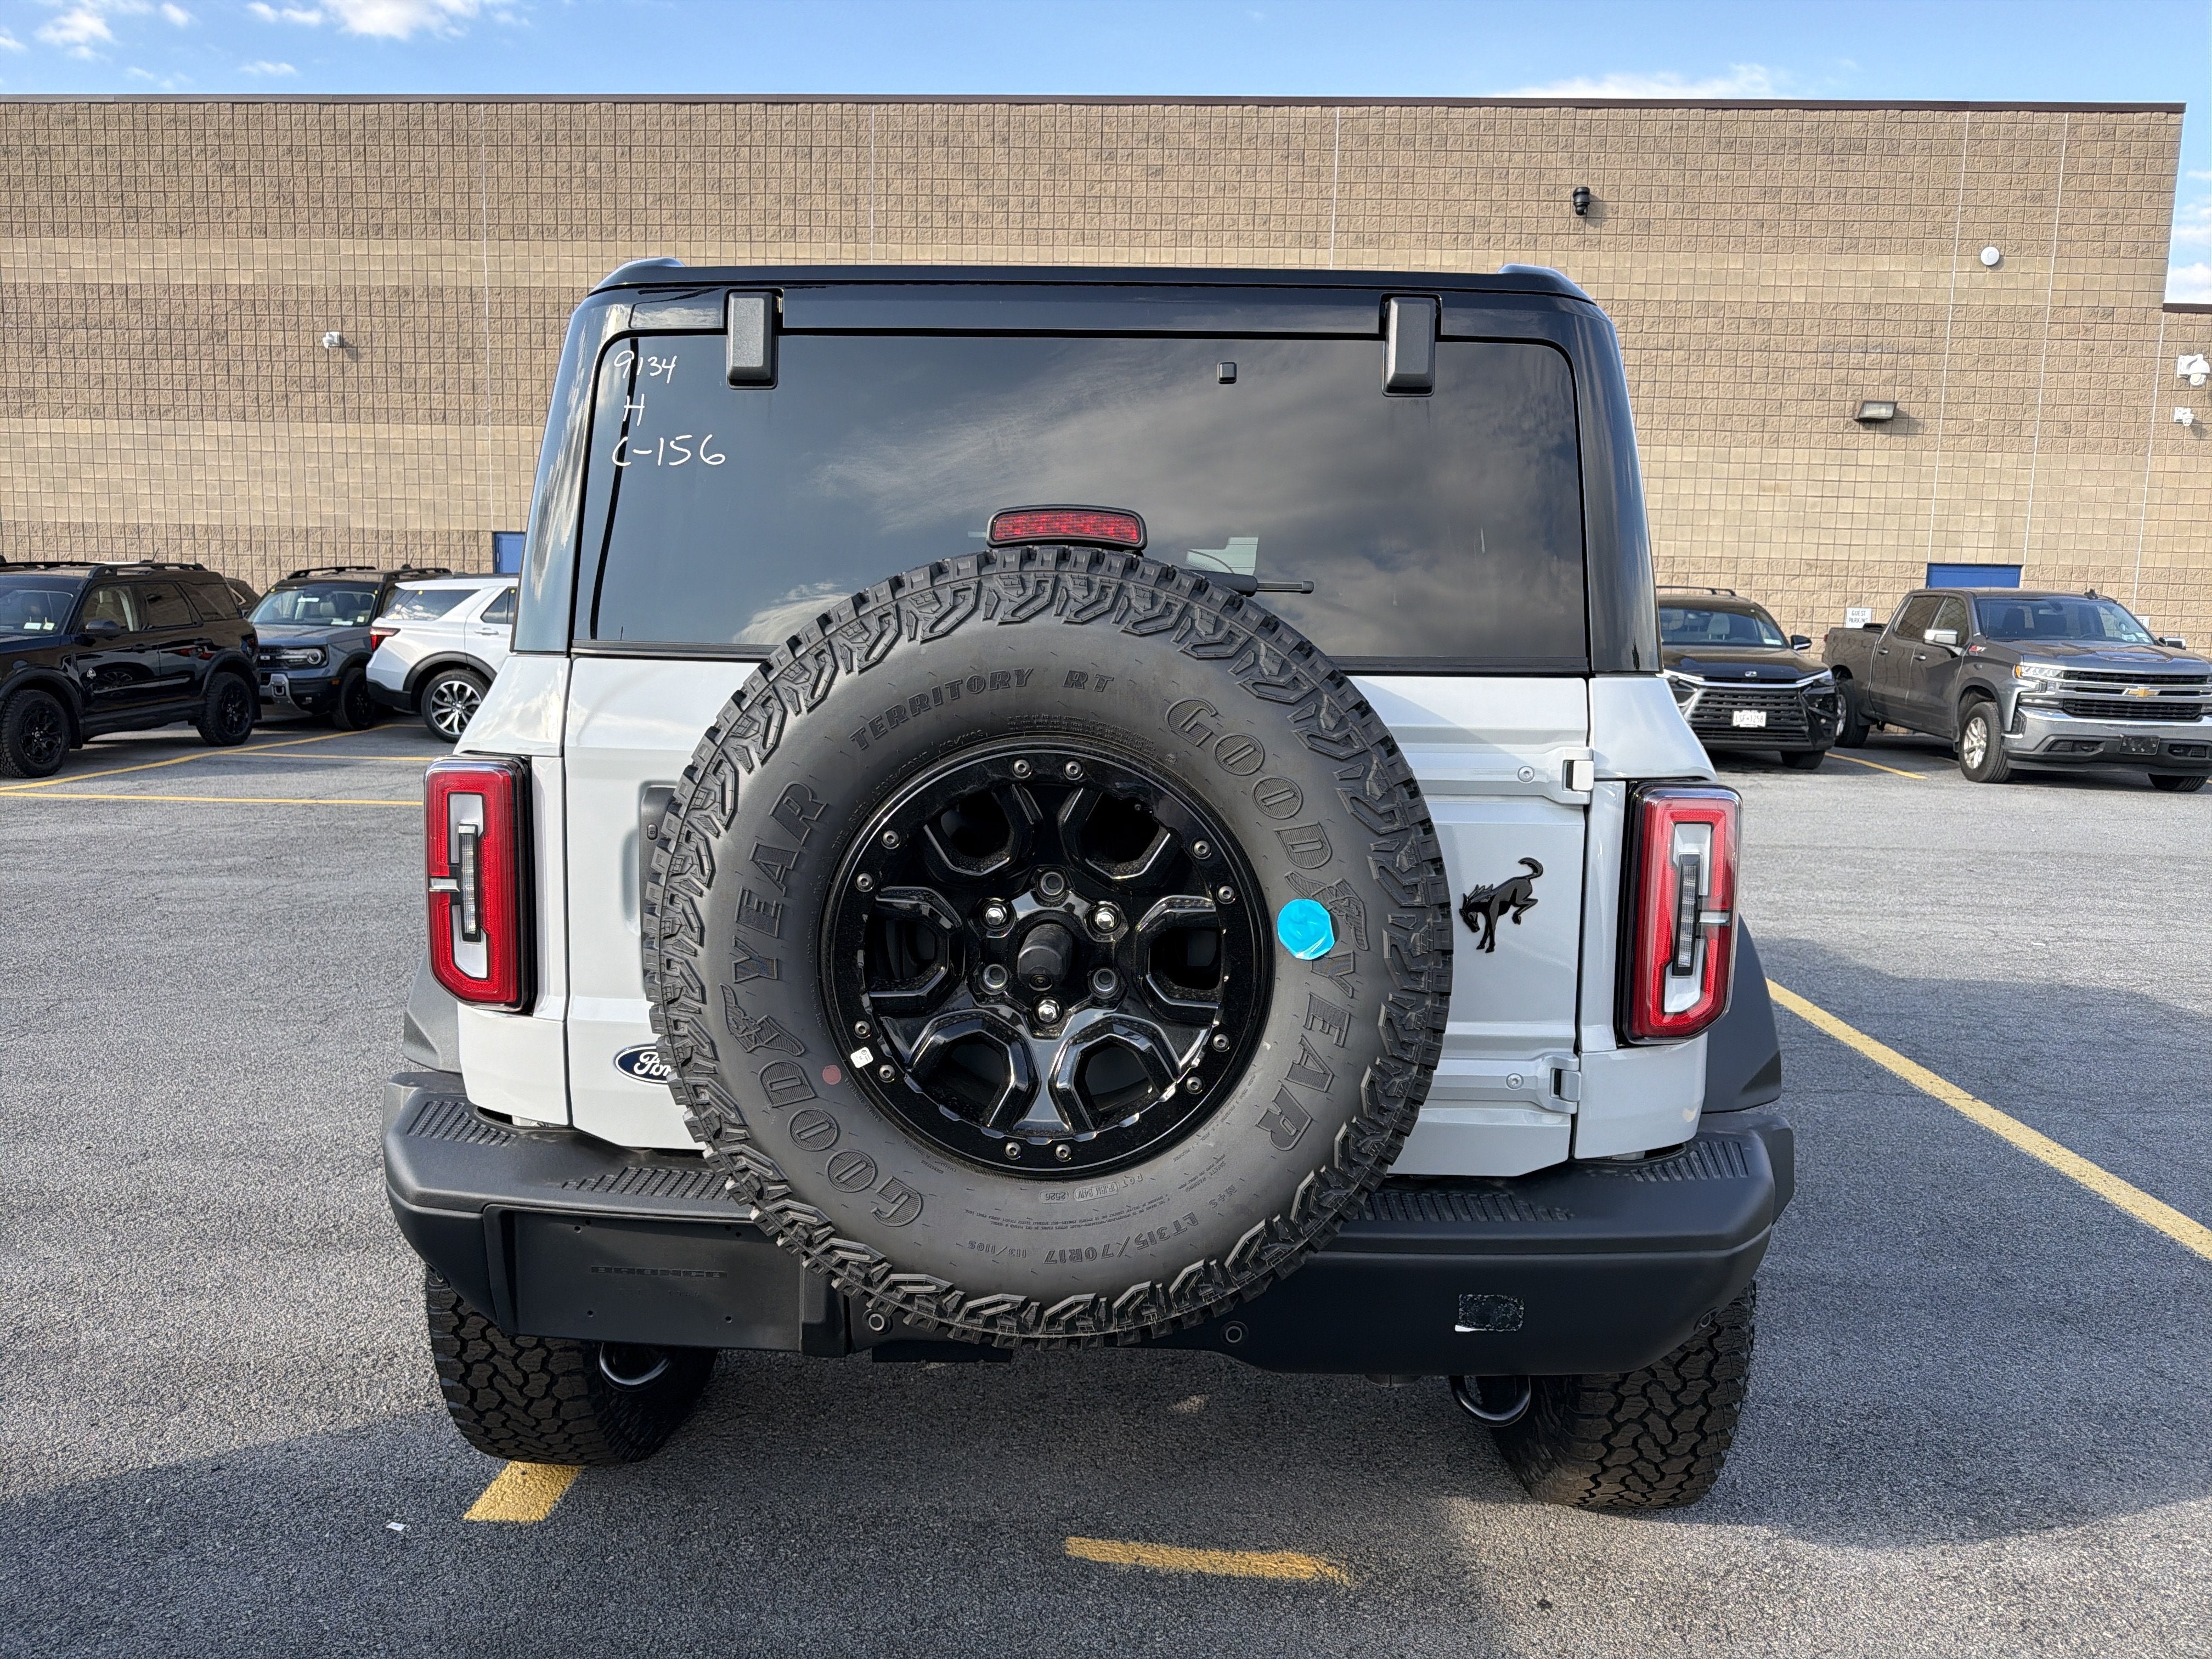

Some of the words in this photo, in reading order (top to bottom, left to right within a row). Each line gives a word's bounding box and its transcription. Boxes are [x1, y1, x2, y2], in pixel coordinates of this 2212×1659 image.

[613, 350, 678, 383] 9134
[623, 393, 645, 426] H
[612, 434, 726, 466] C-156
[849, 668, 1034, 751] TERRITORY
[1062, 669, 1114, 693] RT
[633, 1051, 672, 1075] For
[1043, 1211, 1199, 1265] LT315/70R17
